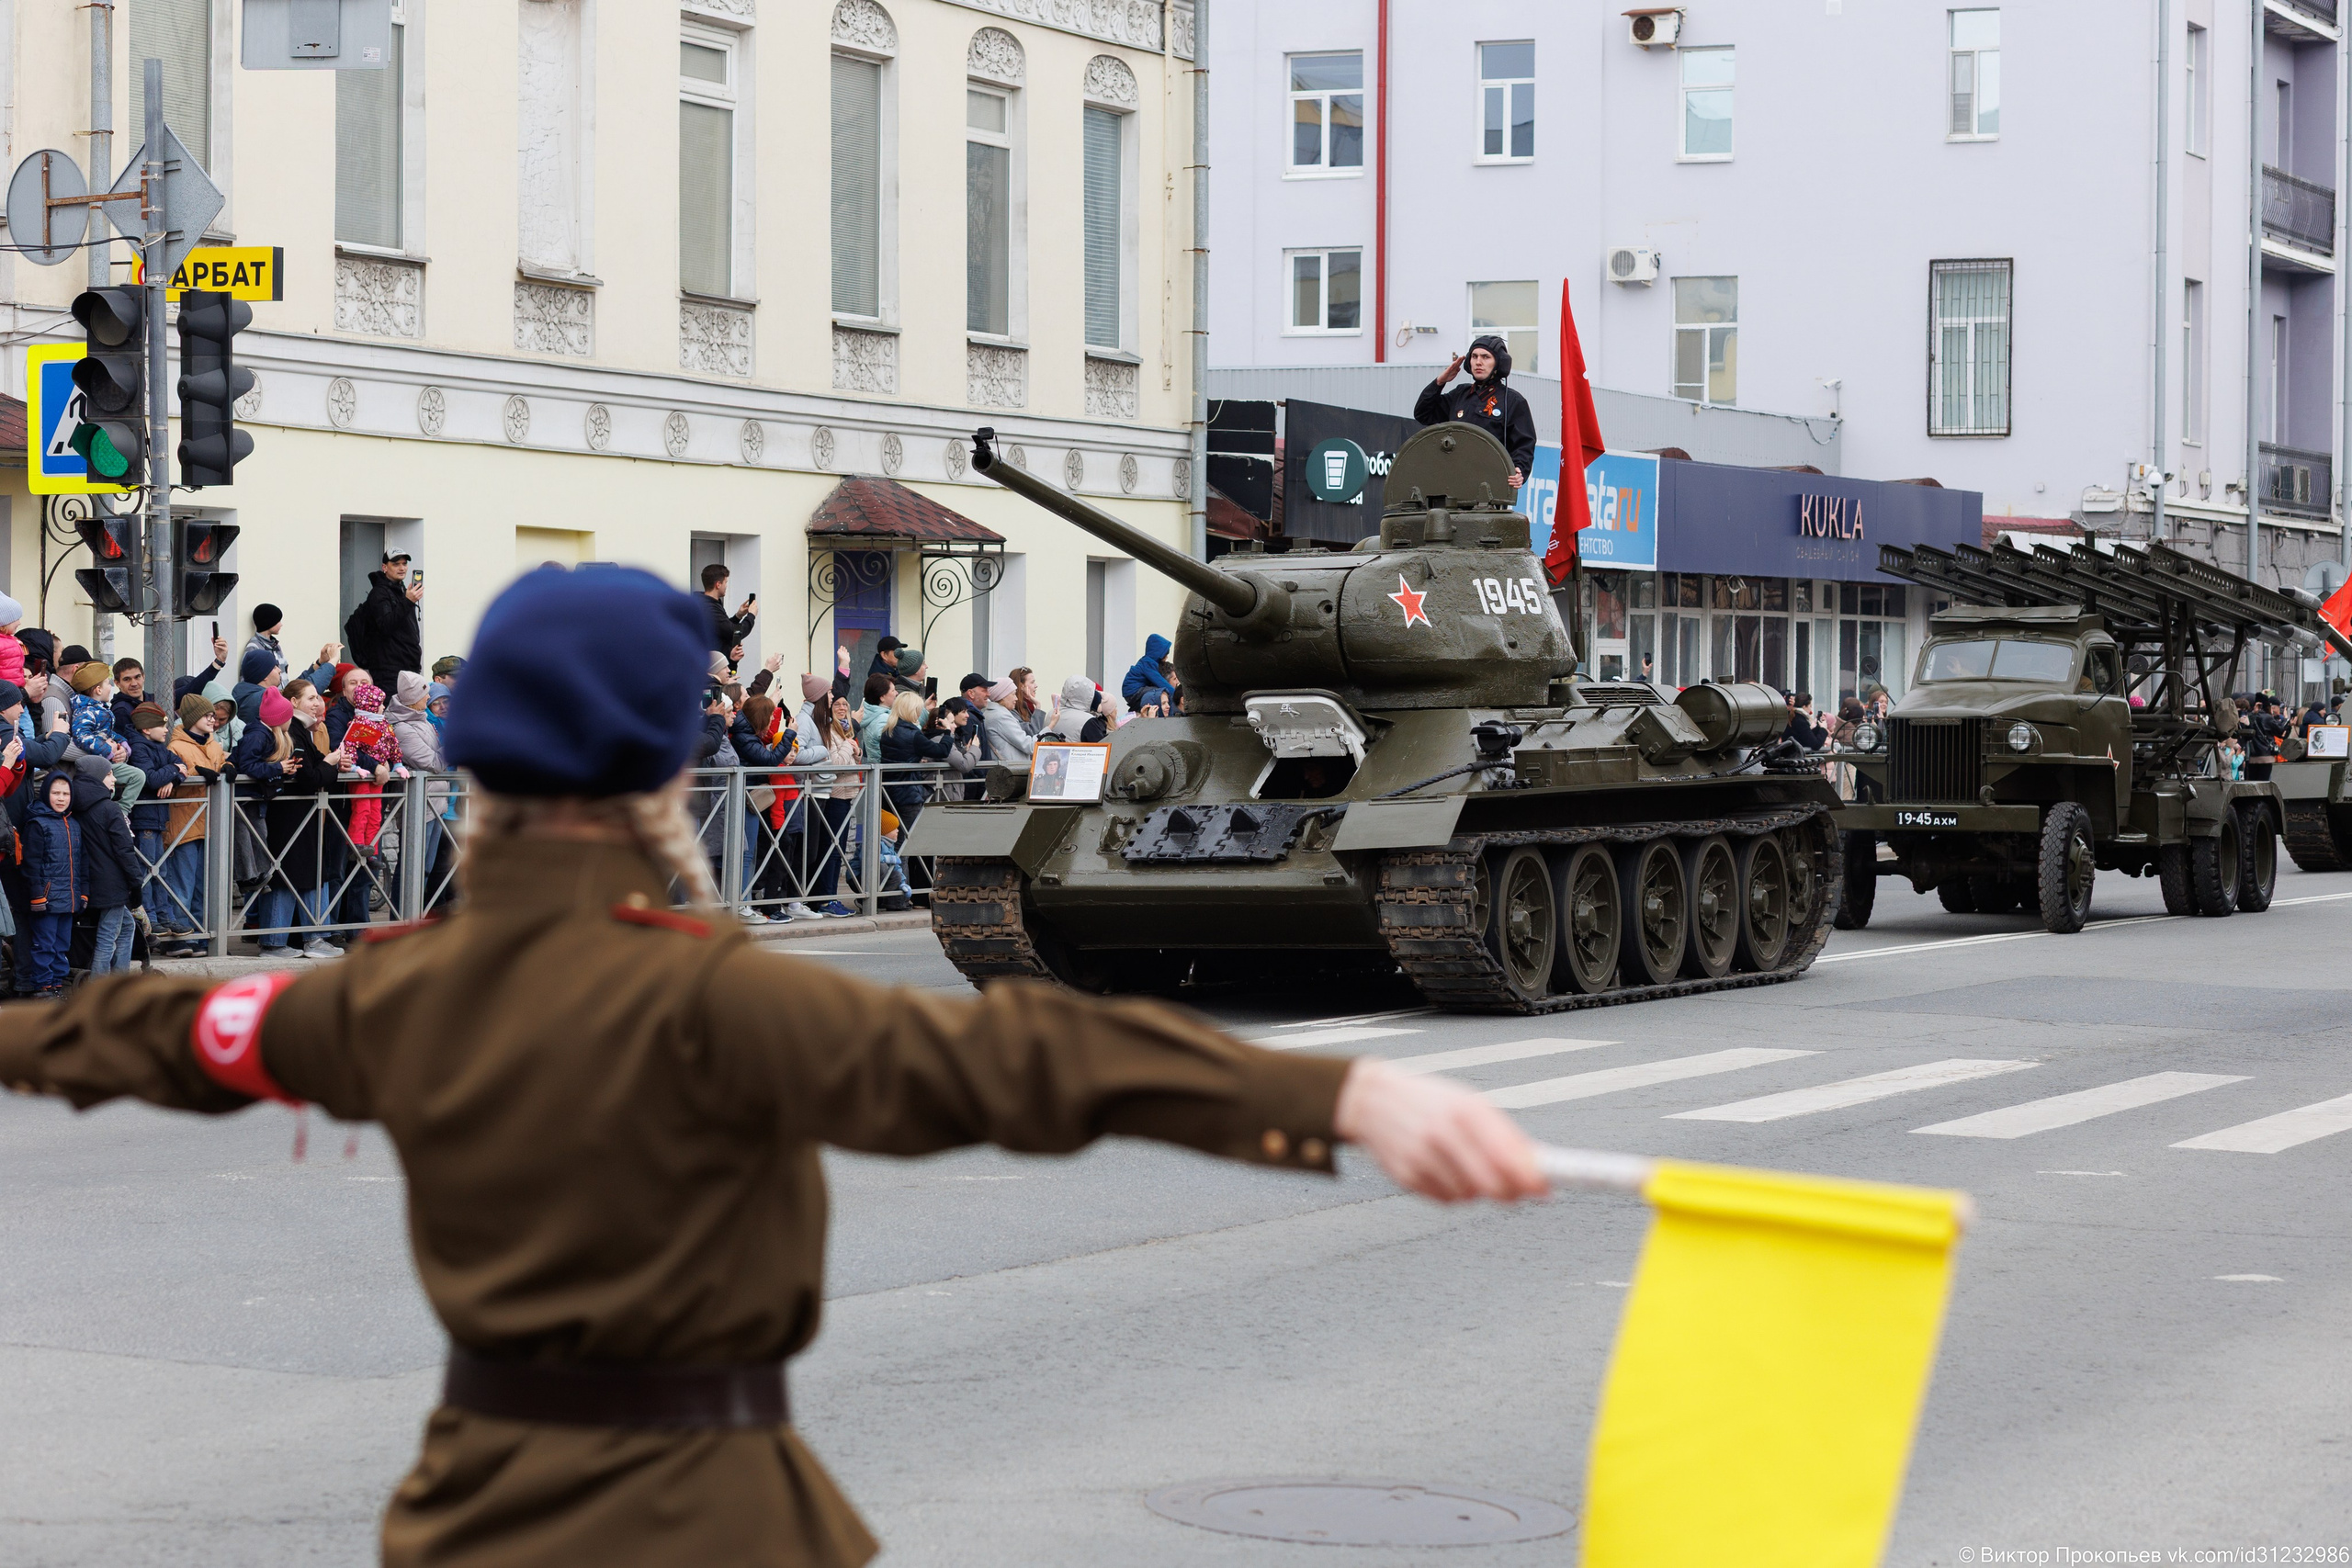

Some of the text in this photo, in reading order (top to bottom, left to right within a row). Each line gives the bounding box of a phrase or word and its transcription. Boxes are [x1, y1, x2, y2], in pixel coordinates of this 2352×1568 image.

[172, 262, 266, 288] АРБАТ
[1525, 469, 1642, 533] traata.ru
[1801, 493, 1863, 540] KUKLA
[1472, 578, 1543, 615] 1945
[1898, 812, 1957, 826] 19-45 АХМ
